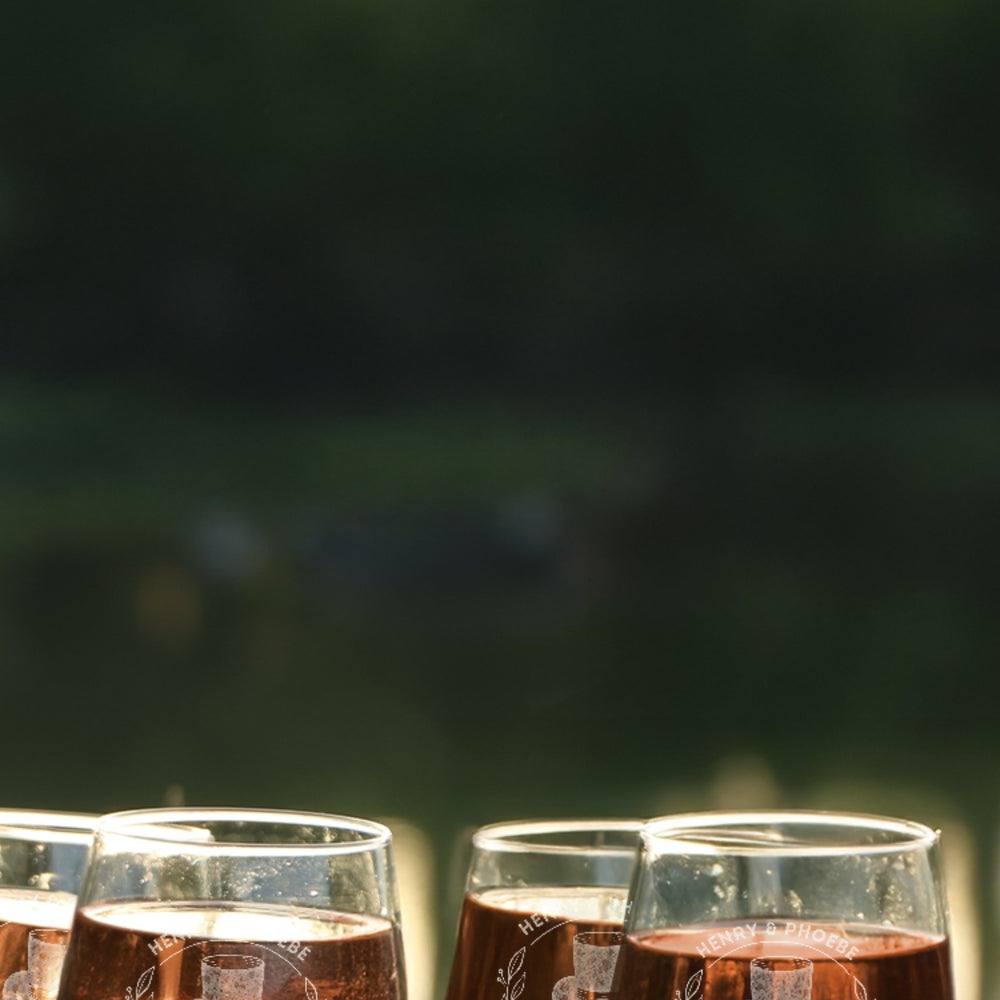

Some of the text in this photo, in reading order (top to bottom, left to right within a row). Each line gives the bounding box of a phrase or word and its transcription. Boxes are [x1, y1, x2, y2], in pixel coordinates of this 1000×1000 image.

[695, 922, 860, 960] HENRY & PHOEBE
